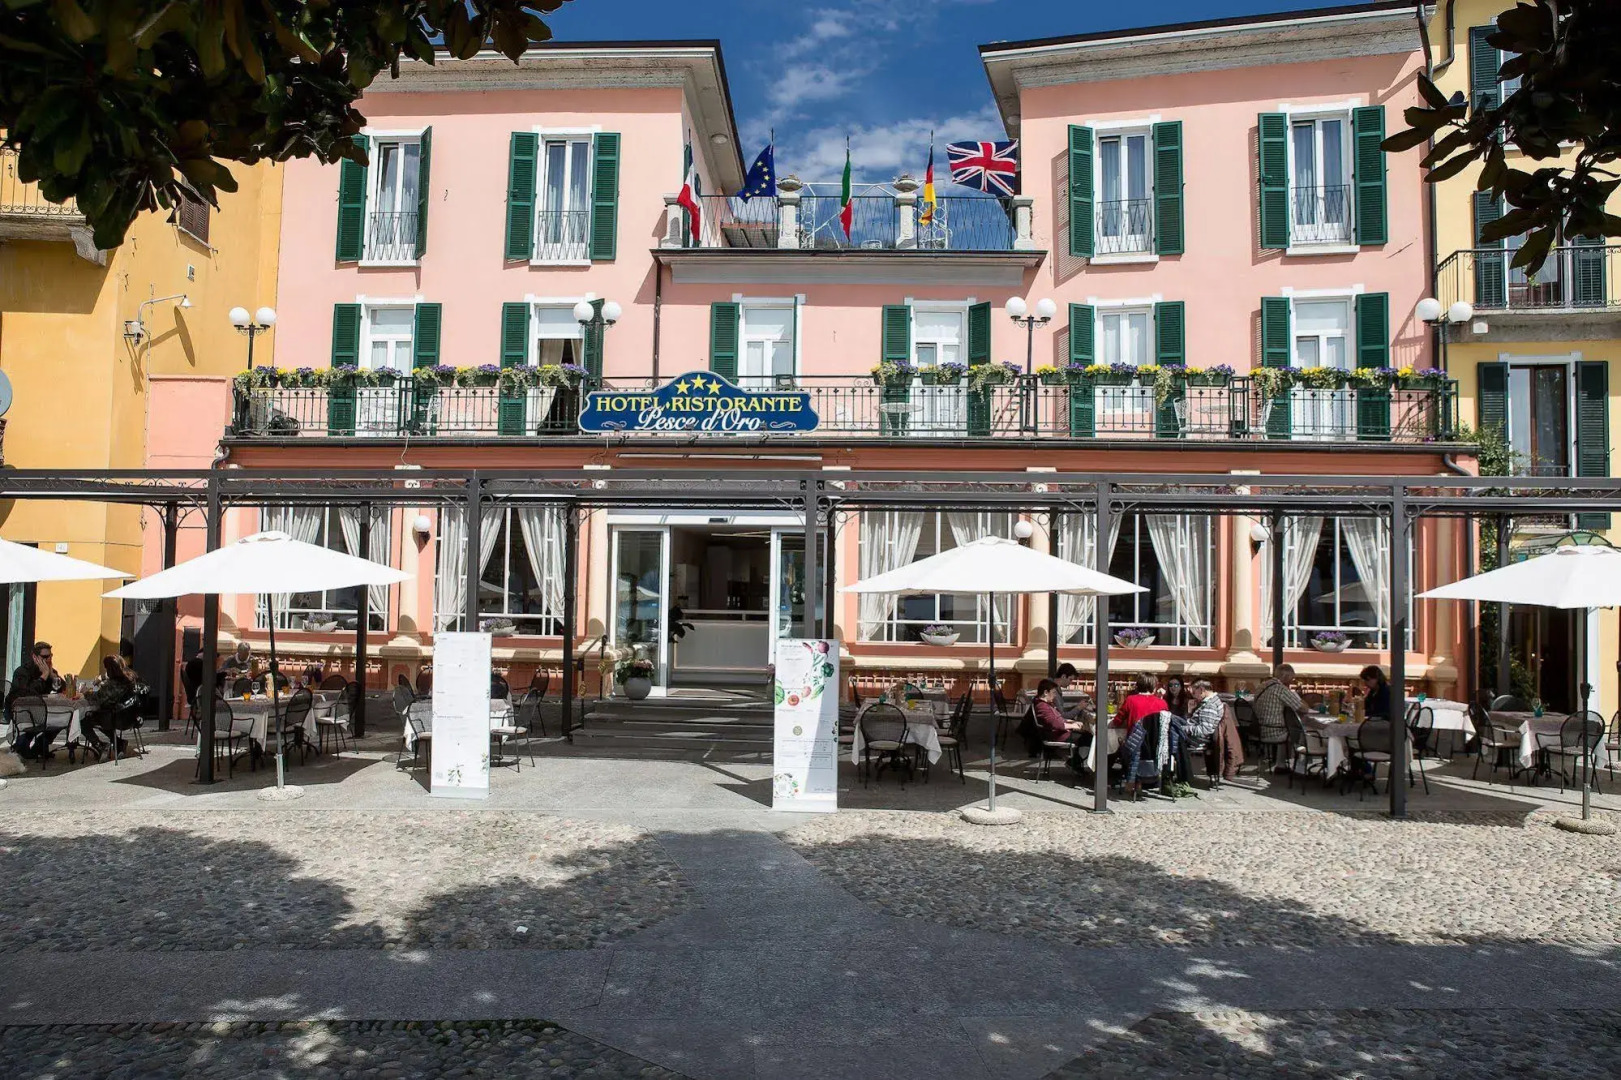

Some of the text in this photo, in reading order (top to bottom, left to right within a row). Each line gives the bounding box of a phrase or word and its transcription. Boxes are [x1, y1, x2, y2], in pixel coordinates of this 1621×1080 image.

[596, 397, 802, 412] HOTEL RISTORANTE
[634, 406, 761, 431] Pesce d'Oro
